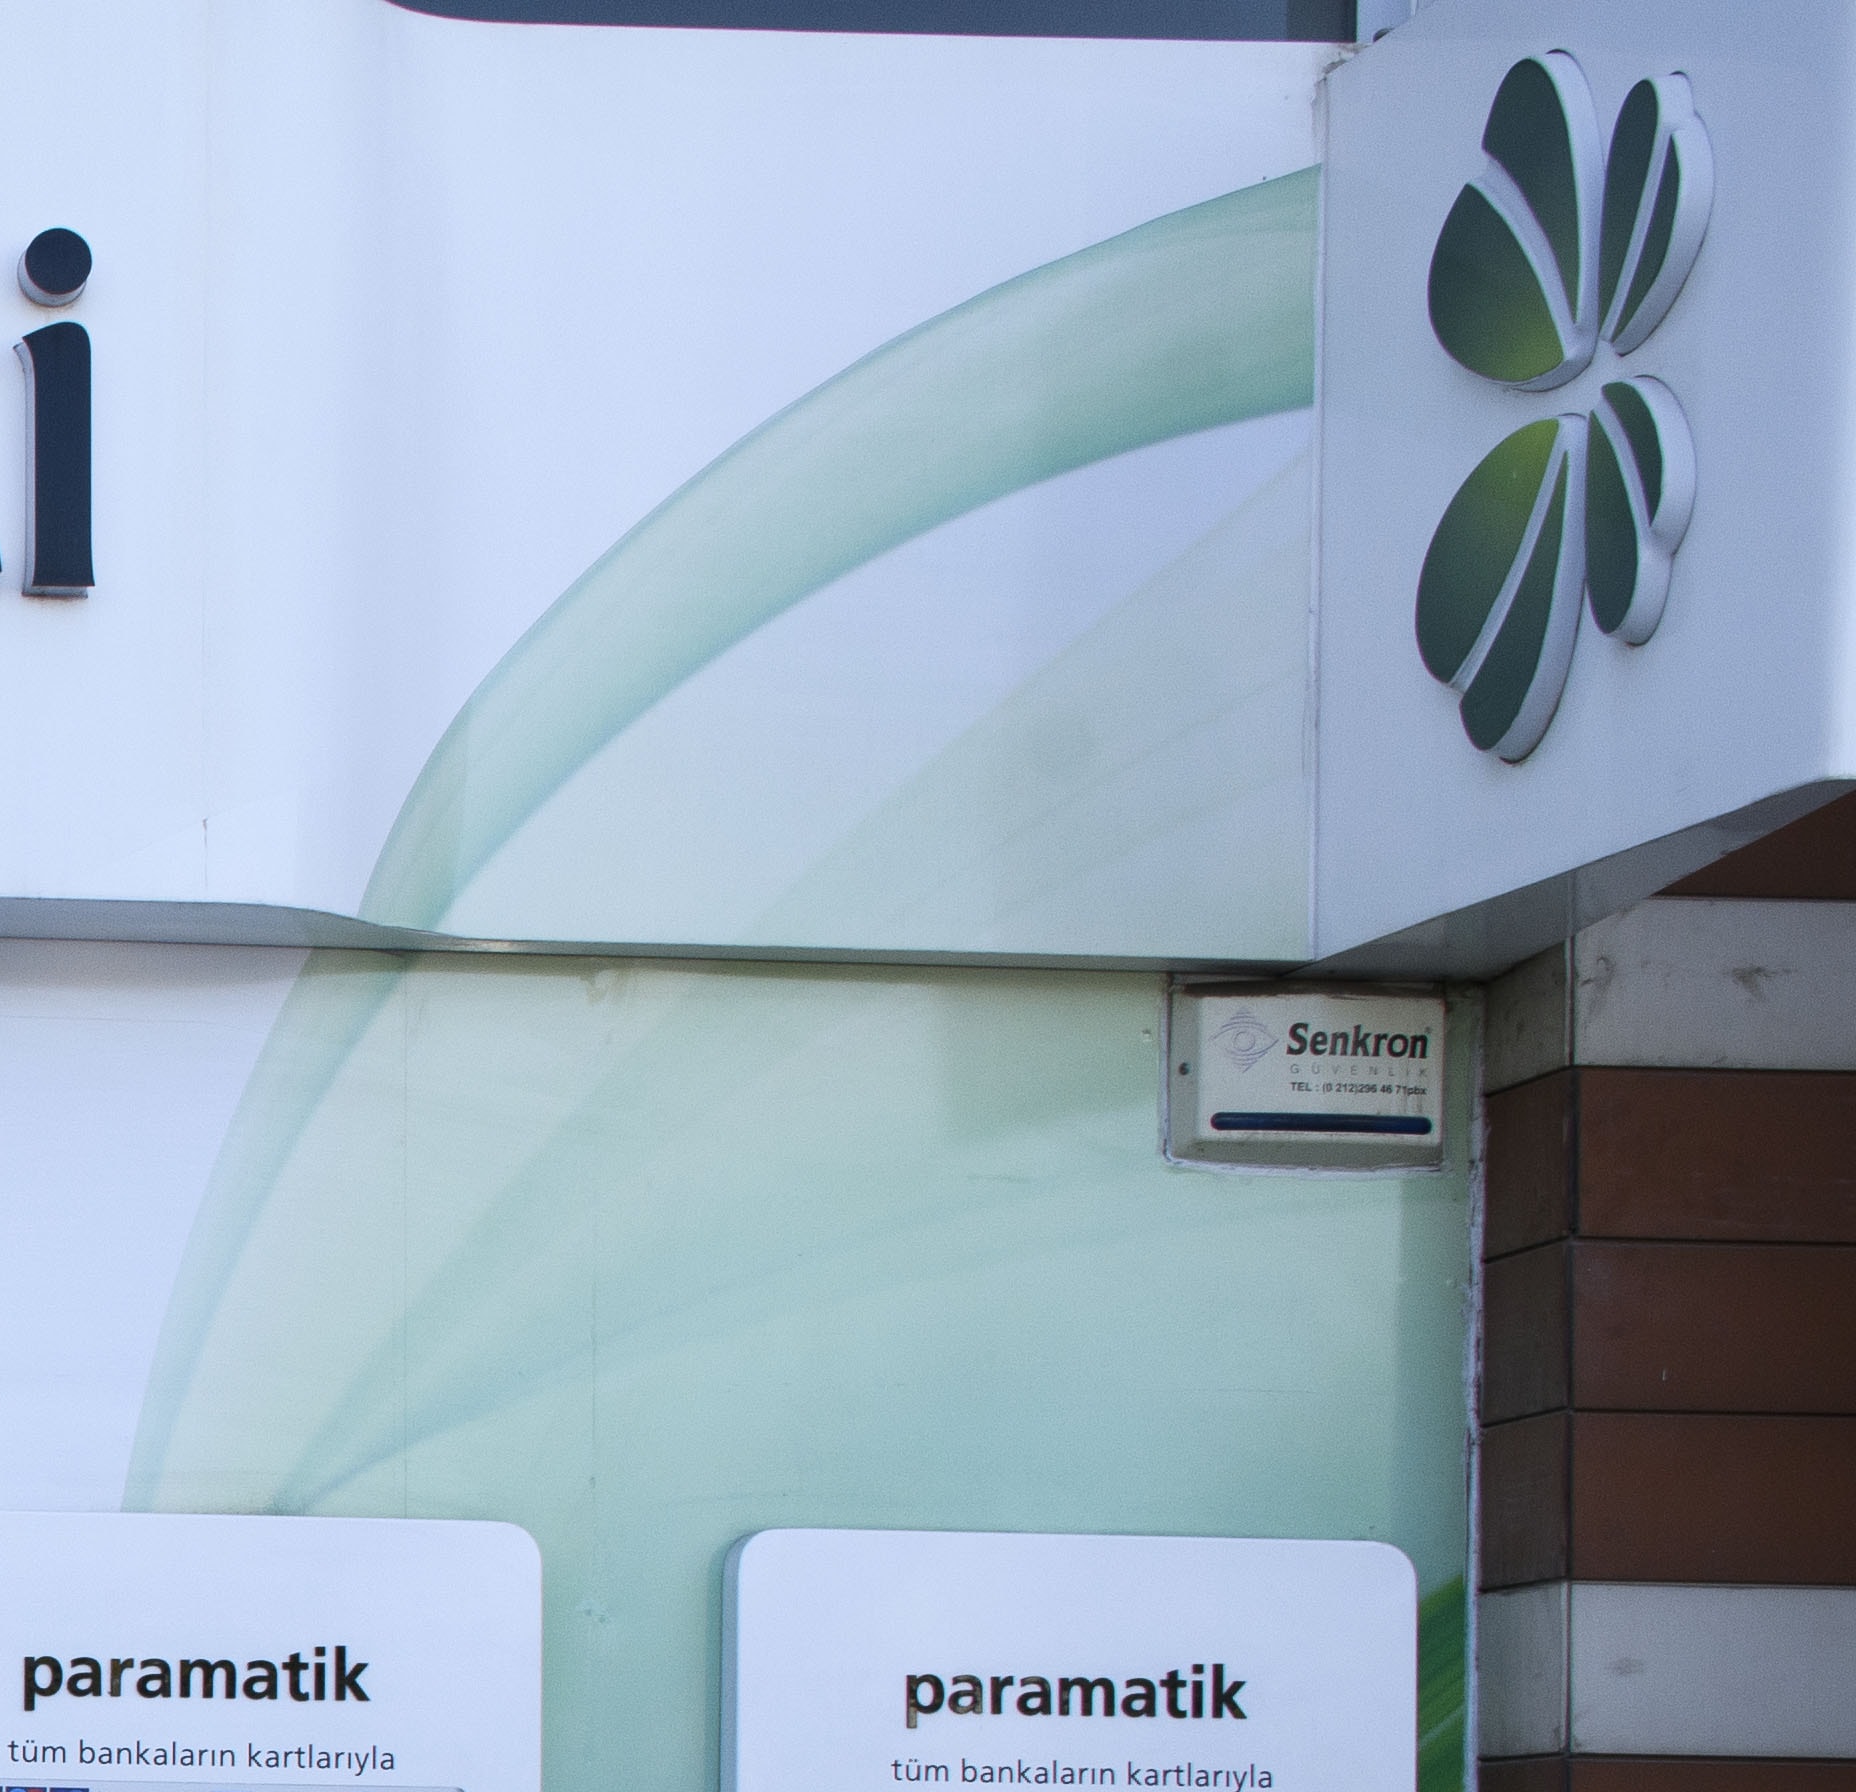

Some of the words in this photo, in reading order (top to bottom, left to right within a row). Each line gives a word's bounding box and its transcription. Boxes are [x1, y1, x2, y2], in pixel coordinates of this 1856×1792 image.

[1286, 1022, 1429, 1059] Senkron
[1290, 1081, 1312, 1093] TEL
[22, 1645, 371, 1711] paramatik
[905, 1663, 1247, 1730] paramatik
[7, 1738, 66, 1765] tüm
[78, 1740, 235, 1768] bankaların
[247, 1744, 396, 1774] kartlarıyla
[891, 1758, 949, 1784] tüm
[961, 1759, 1115, 1787] bankaların
[1127, 1760, 1273, 1792] kartlarıyla
